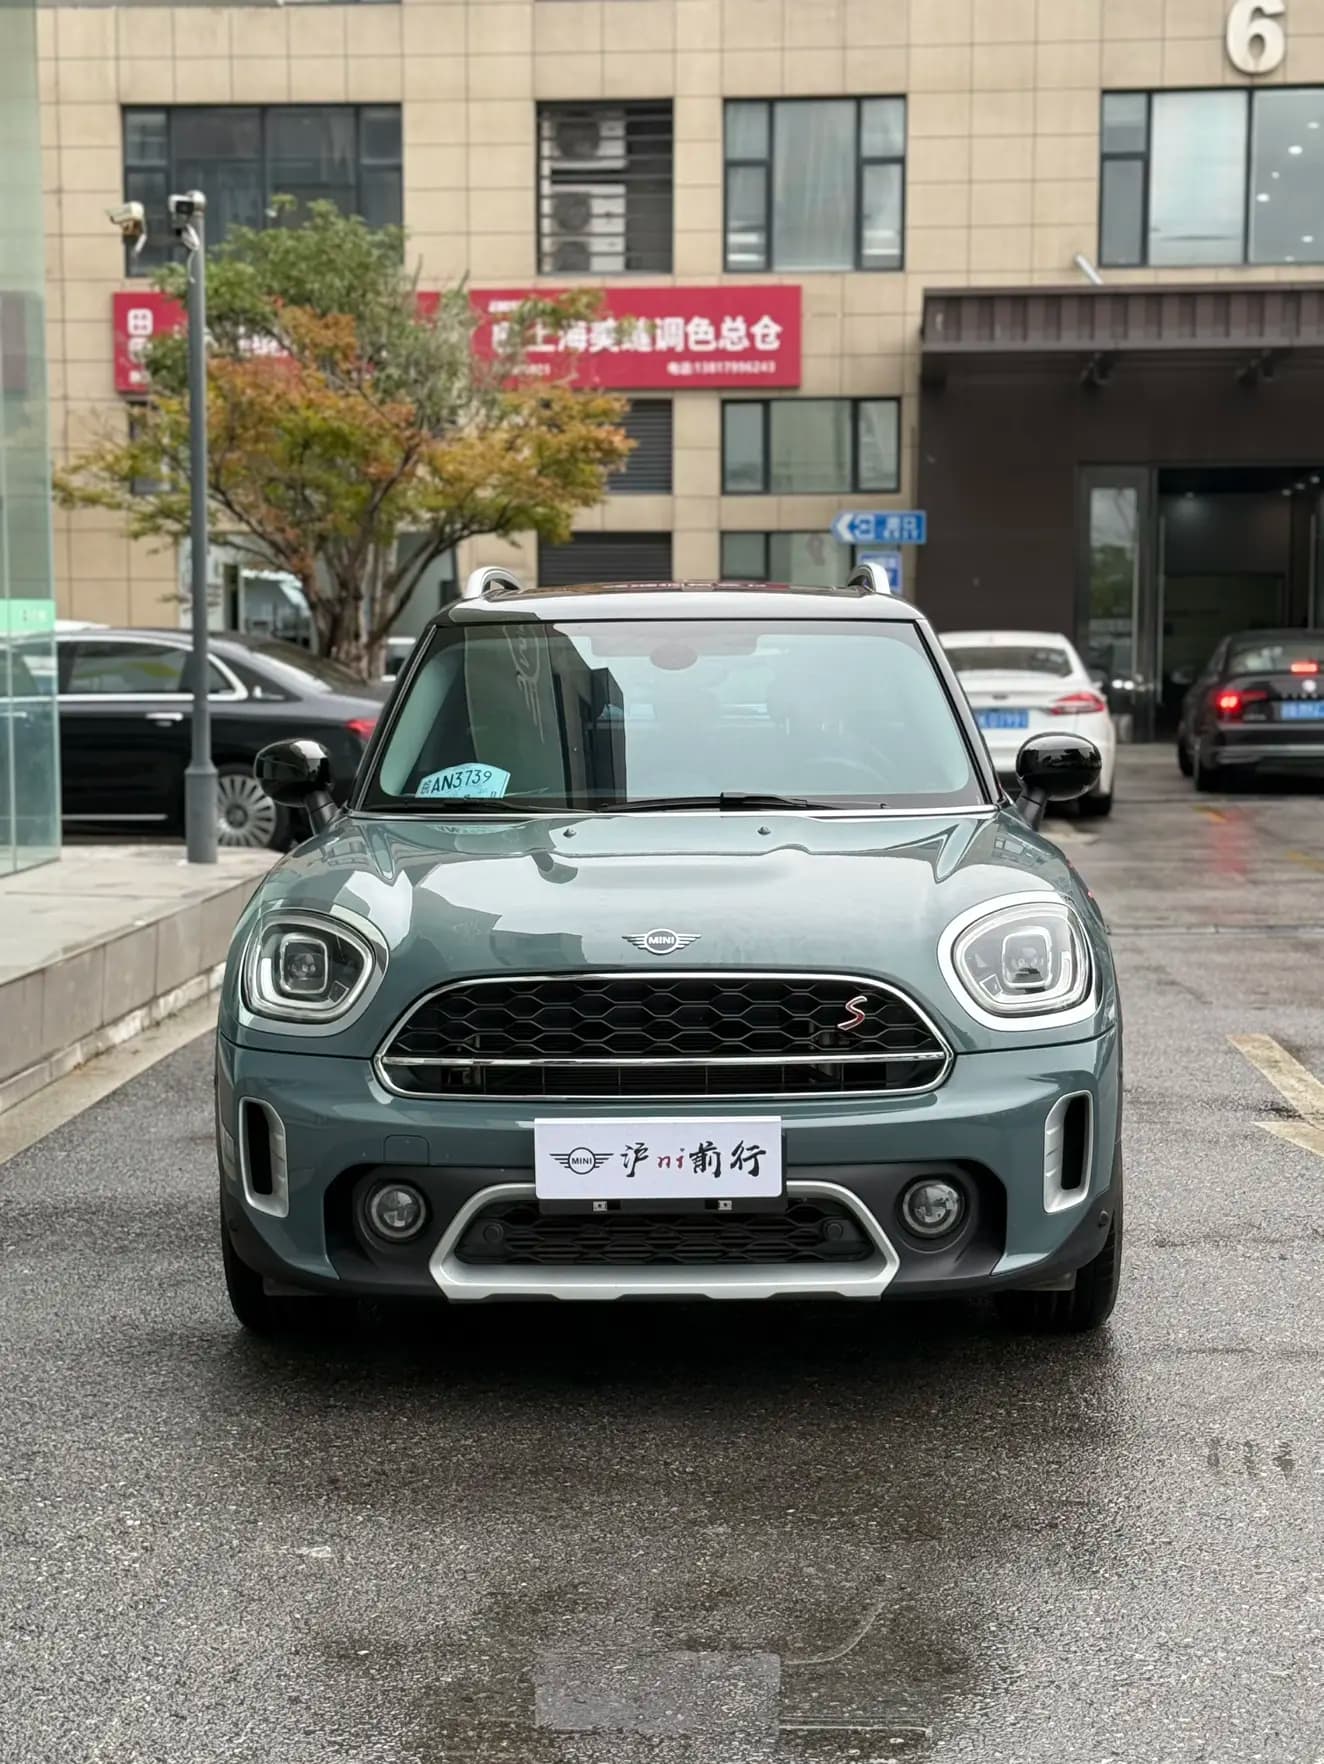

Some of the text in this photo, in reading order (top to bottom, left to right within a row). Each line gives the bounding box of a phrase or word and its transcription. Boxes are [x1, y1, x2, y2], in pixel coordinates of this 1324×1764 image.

[1226, 0, 1286, 73] 6
[647, 935, 676, 945] MINI
[837, 995, 868, 1031] S
[571, 1157, 593, 1166] MINI
